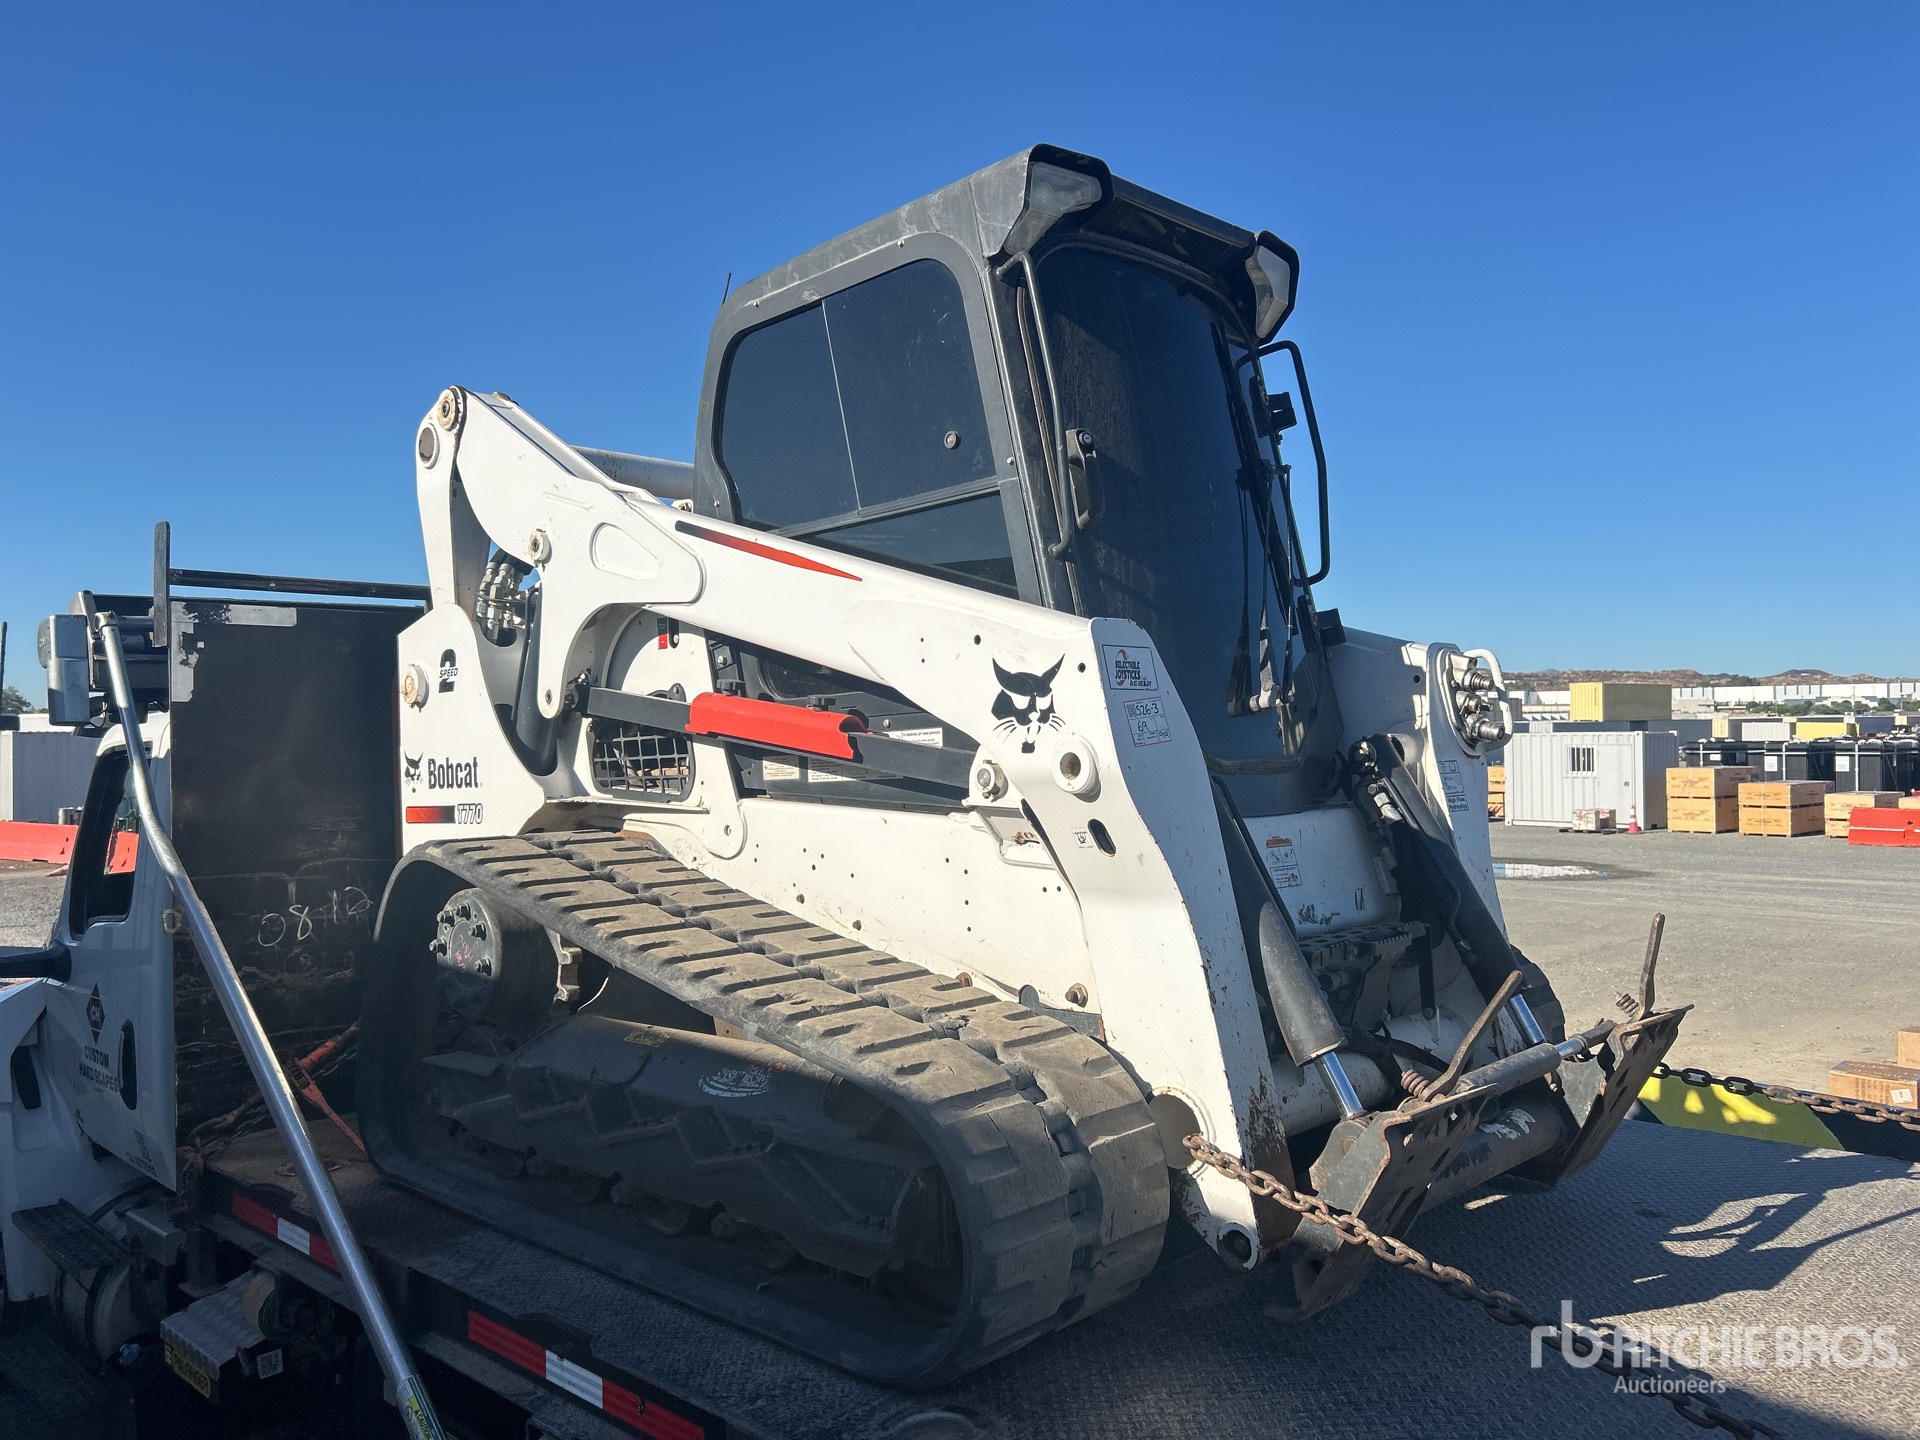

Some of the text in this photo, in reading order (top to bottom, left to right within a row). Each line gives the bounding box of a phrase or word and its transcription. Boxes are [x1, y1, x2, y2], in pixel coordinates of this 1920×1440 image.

[439, 667, 459, 679] SPEED
[1115, 660, 1140, 670] SELECTABLE
[1115, 669, 1141, 680] JOYSTICKS
[427, 756, 479, 790] Bobcat
[456, 803, 484, 825] T770
[84, 1045, 110, 1068] CUSTOM
[78, 1061, 119, 1093] HARDSCAPES
